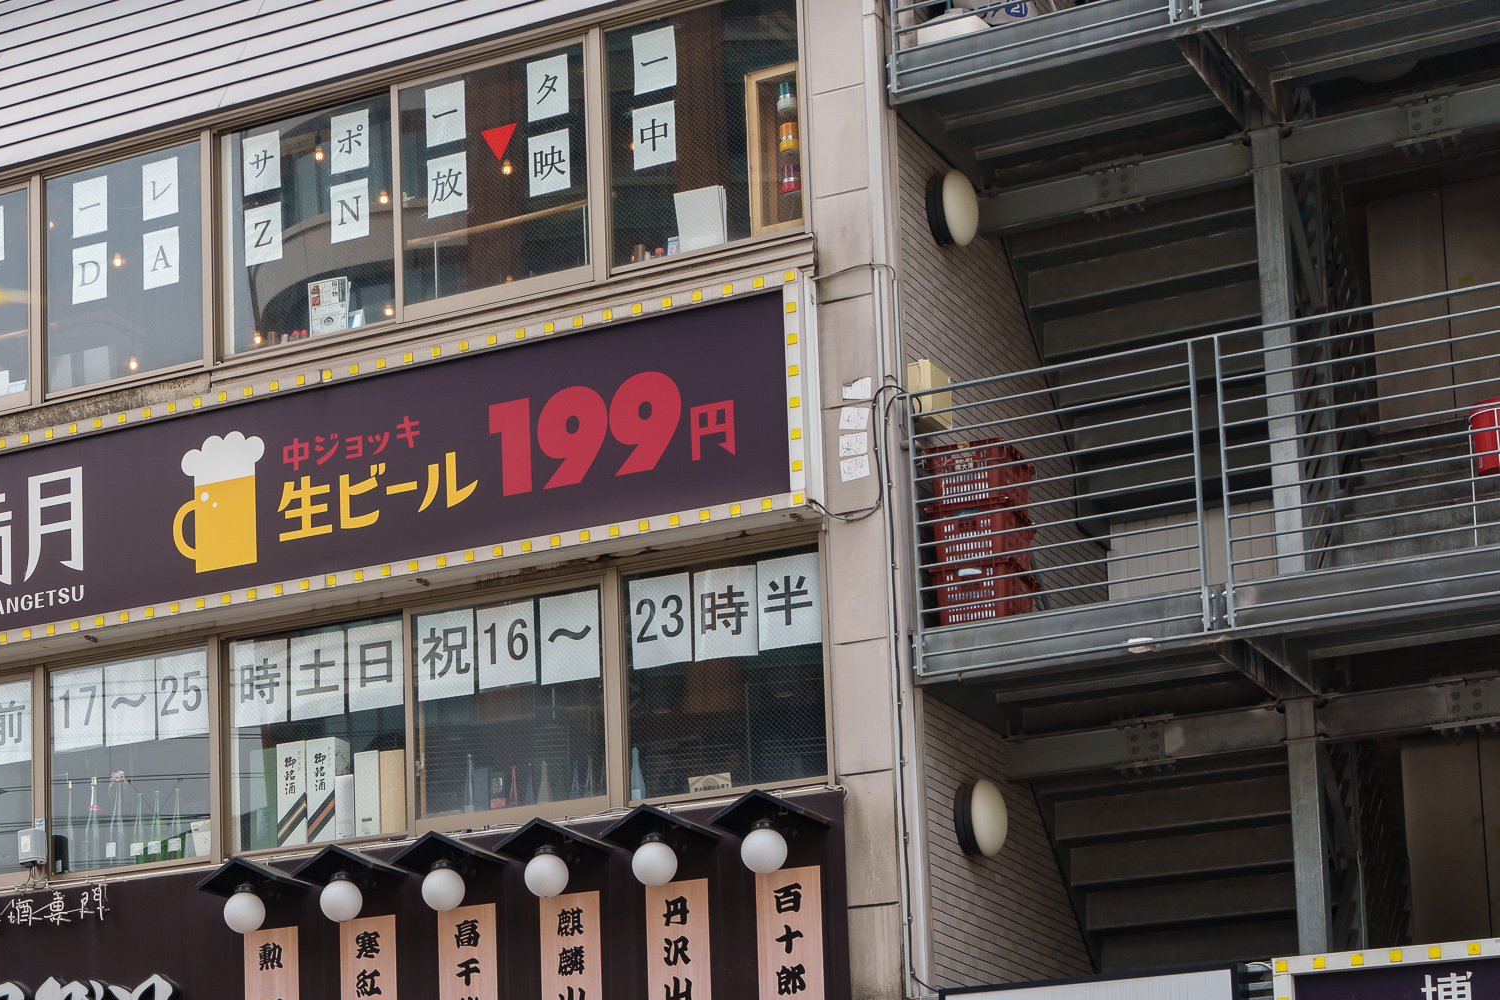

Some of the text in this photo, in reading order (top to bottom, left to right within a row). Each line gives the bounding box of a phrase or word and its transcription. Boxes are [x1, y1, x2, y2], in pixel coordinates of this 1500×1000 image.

[281, 414, 422, 471] 中ジョッキ
[488, 370, 737, 498] 199円
[276, 451, 480, 543] 生ビール
[773, 882, 807, 996] 百十郎
